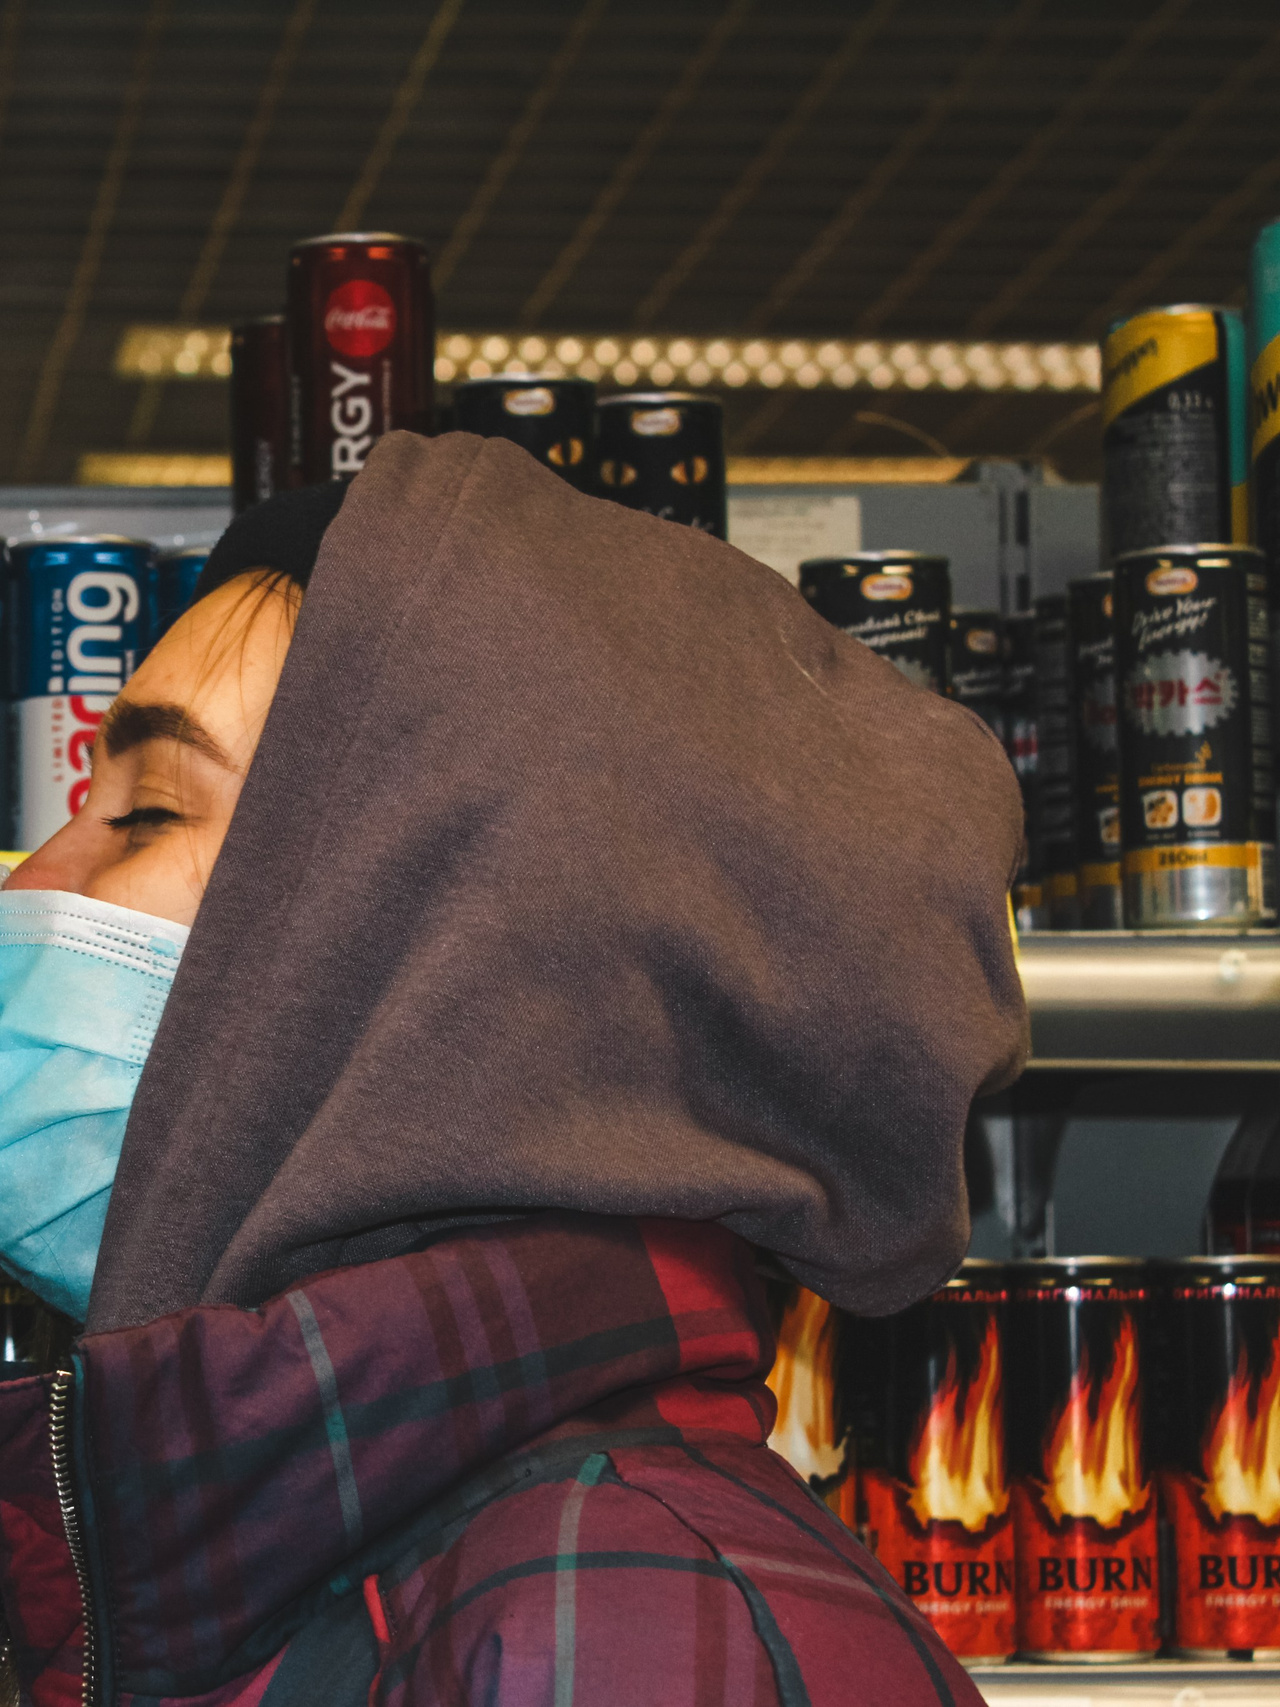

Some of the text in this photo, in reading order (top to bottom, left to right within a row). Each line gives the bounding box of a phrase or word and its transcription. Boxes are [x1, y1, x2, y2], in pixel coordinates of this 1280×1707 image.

[331, 361, 372, 480] RGY
[51, 587, 64, 783] LIMITED EDITION
[902, 1560, 1013, 1597] BURN
[1038, 1557, 1152, 1592] BURN
